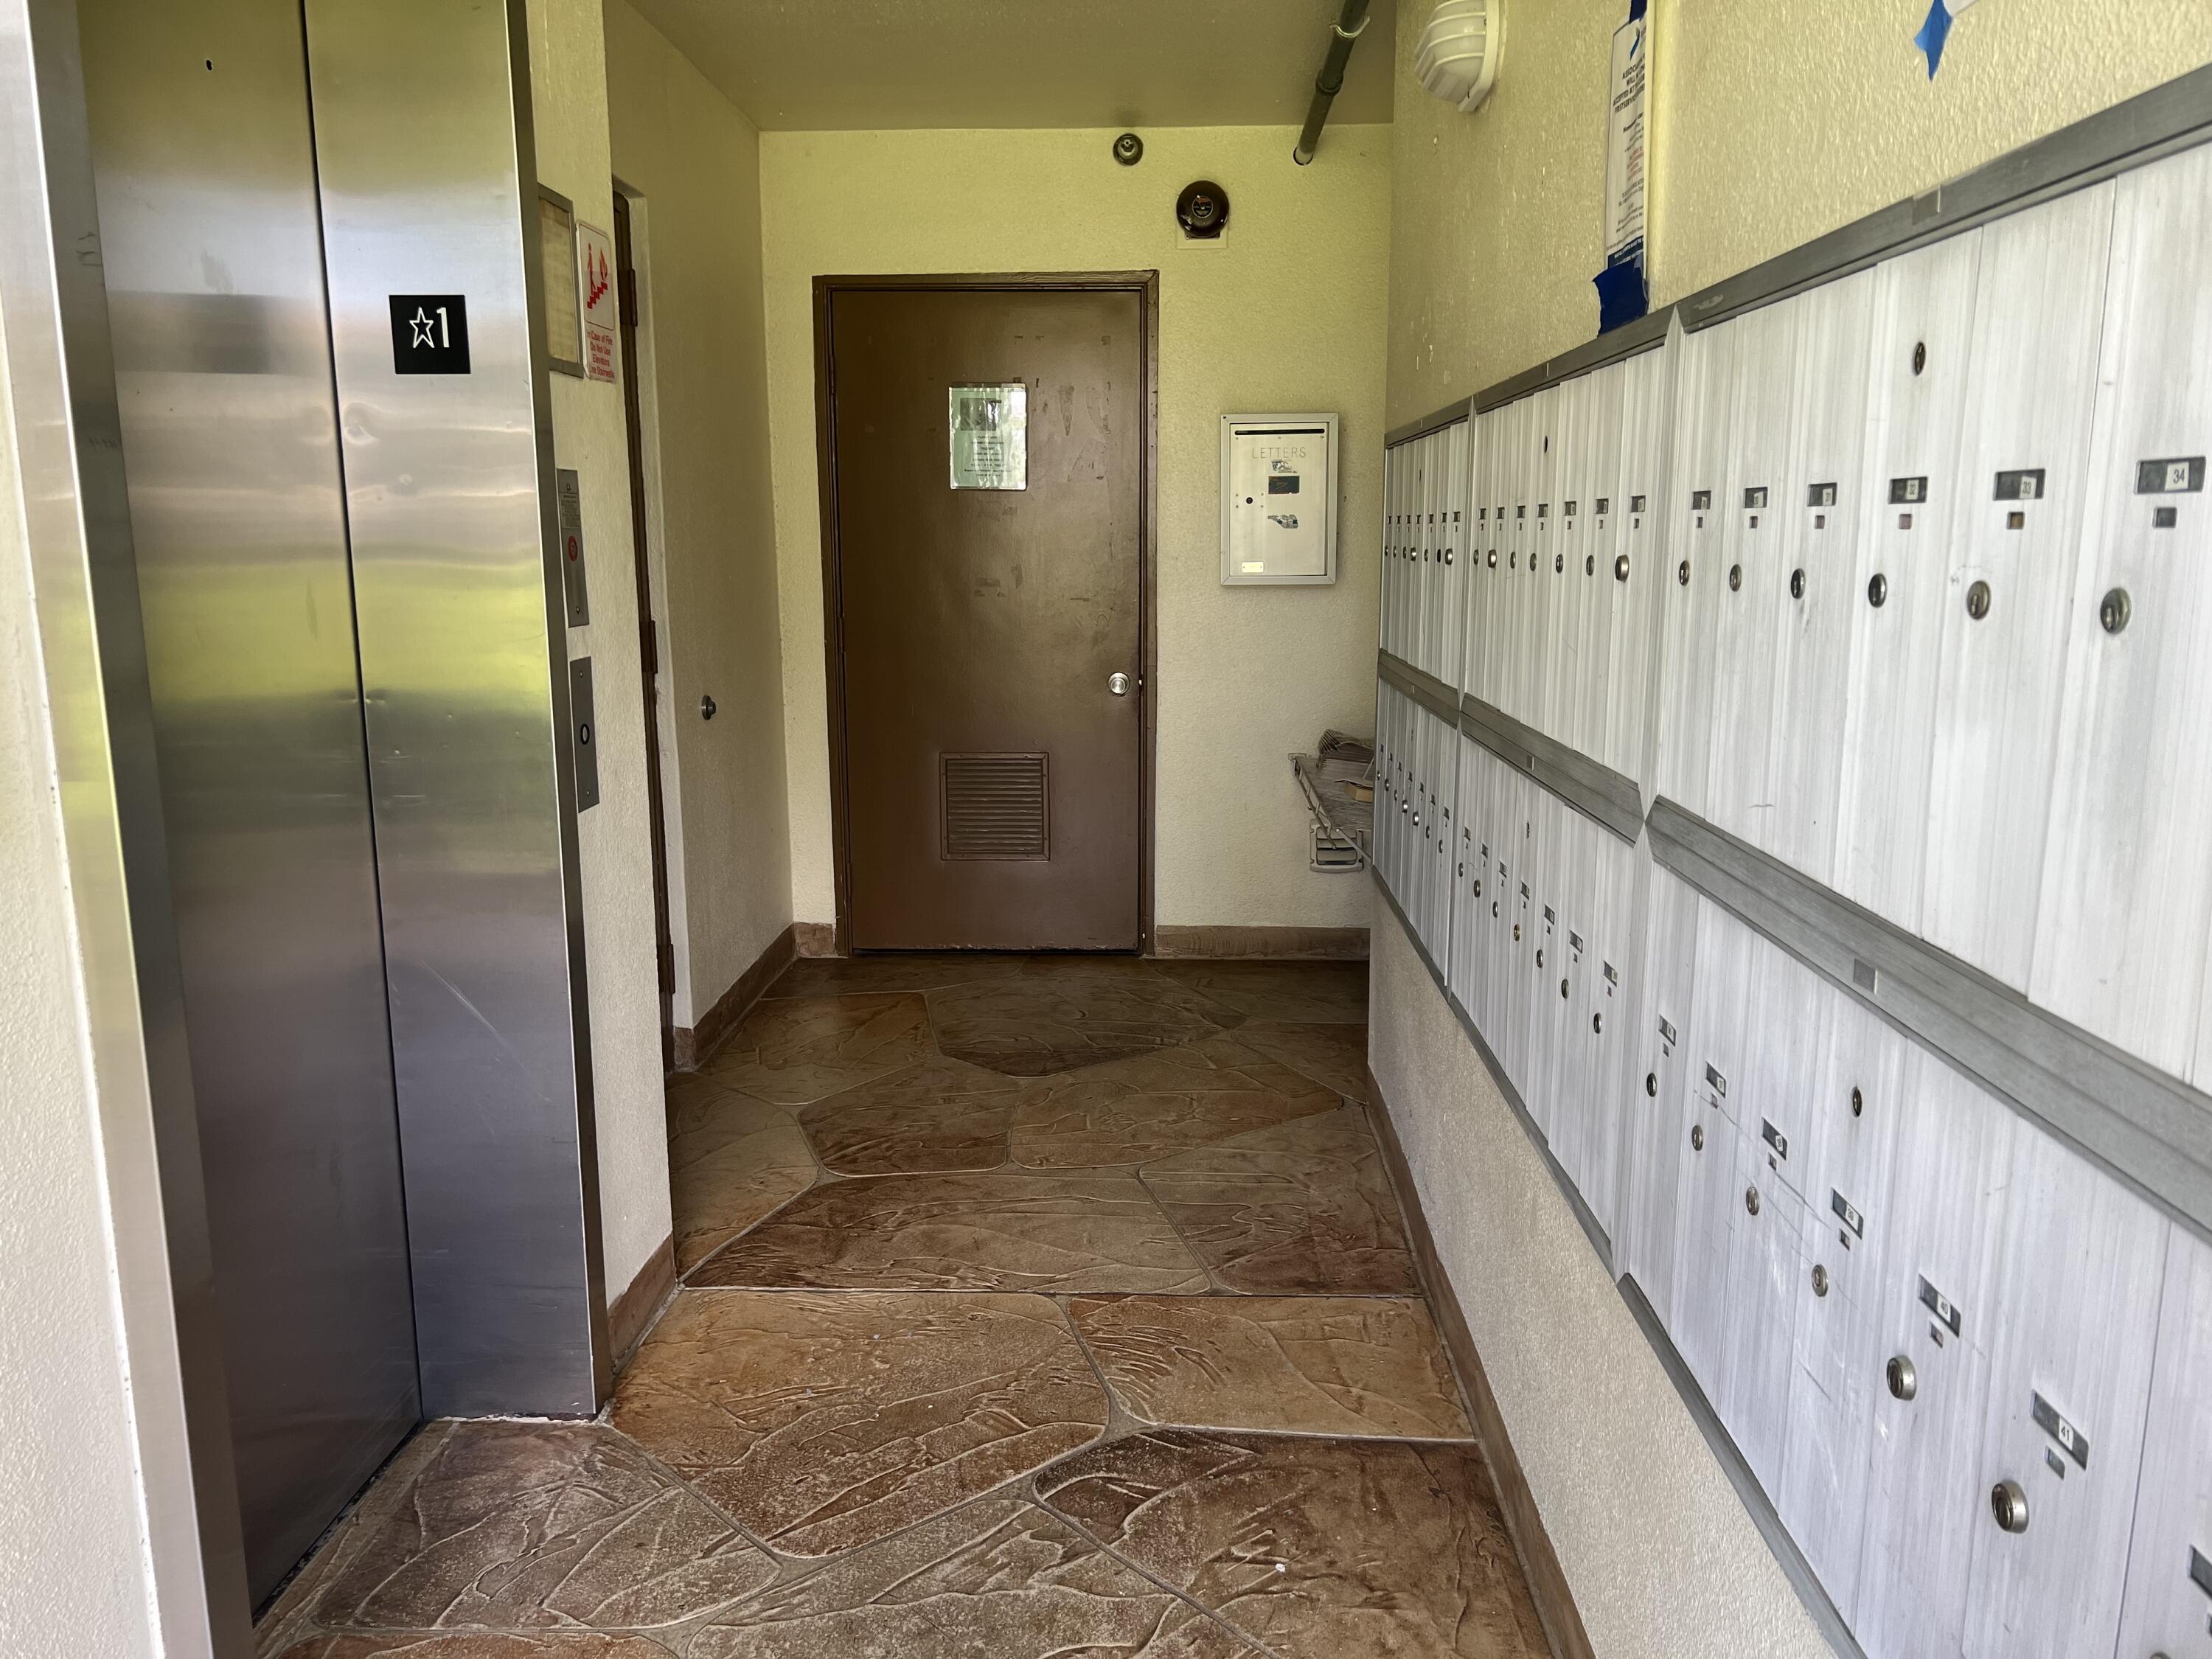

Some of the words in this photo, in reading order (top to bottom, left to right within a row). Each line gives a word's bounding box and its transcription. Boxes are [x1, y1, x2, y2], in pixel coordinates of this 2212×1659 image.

[437, 307, 451, 348] 1
[591, 330, 601, 342] Case
[601, 335, 605, 343] of
[590, 341, 596, 351] Do
[593, 354, 610, 366] Elevators
[1252, 446, 1307, 459] LETTERS
[2173, 467, 2185, 484] 34
[2023, 481, 2032, 495] 33
[1940, 1301, 1949, 1315] 40
[2060, 1425, 2070, 1441] 41
